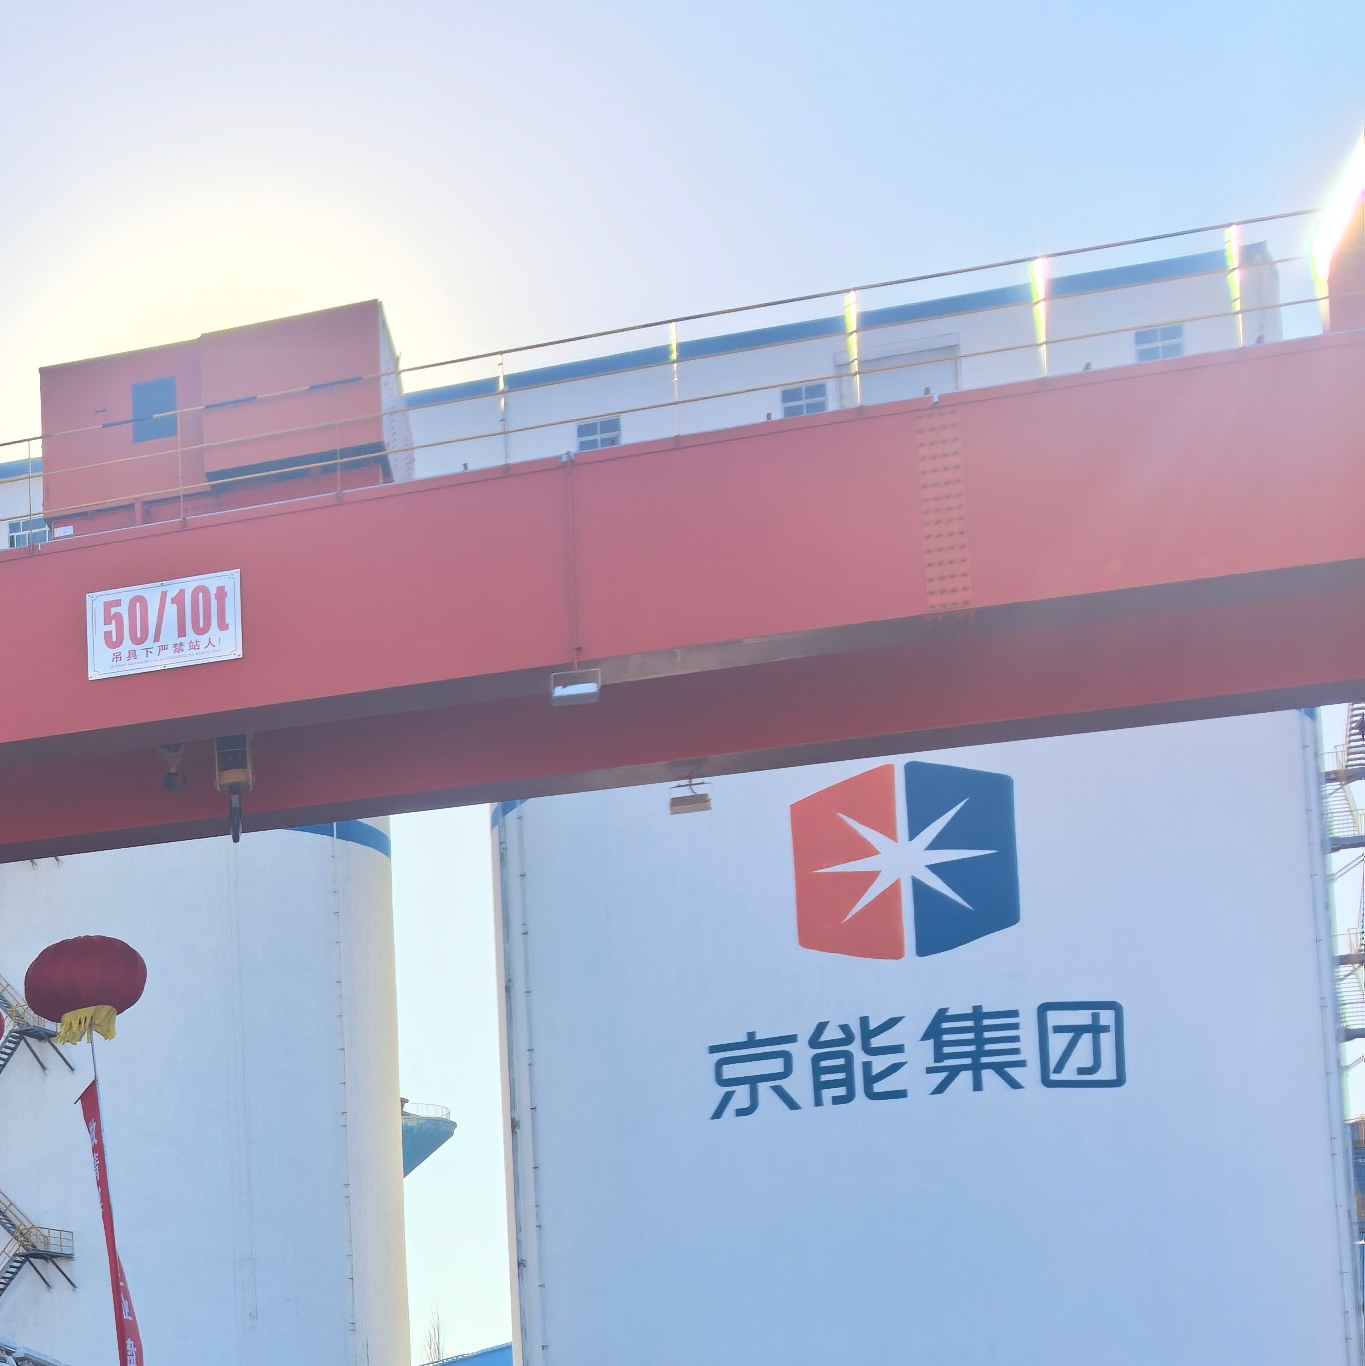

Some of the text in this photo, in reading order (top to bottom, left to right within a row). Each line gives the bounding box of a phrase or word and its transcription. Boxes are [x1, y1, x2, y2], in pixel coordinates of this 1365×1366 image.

[103, 585, 229, 649] 50/10t
[708, 1001, 1127, 1121] 京能集团
